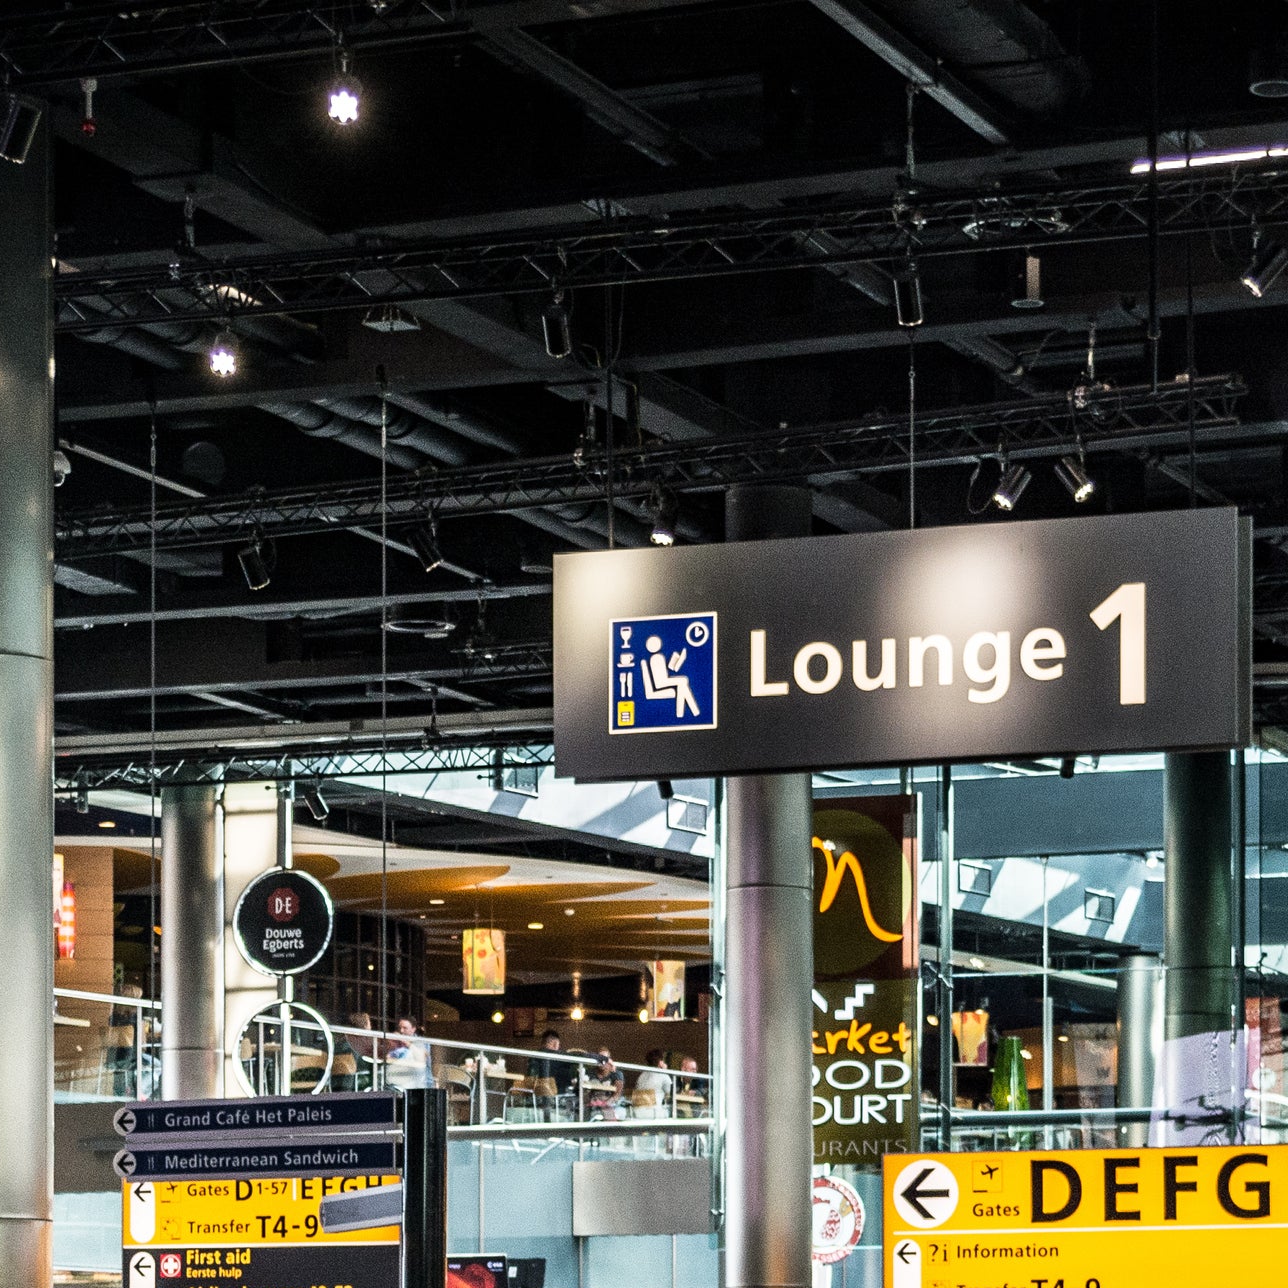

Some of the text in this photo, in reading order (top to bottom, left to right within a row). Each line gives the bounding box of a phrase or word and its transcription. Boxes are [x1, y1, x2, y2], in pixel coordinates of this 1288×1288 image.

[750, 582, 1146, 705] Lounge 1
[266, 928, 302, 938] Douwe
[263, 938, 304, 953] Egberts
[164, 1106, 332, 1127] Grand Café Het Paleis
[813, 1138, 907, 1156] URANTS
[164, 1149, 360, 1169] Mediterranean Sandwich
[187, 1182, 230, 1197] Gates
[972, 1203, 1021, 1218] Gates
[187, 1214, 319, 1239] Transfer T4-9
[186, 1248, 251, 1266] First aid
[956, 1244, 1059, 1259] Information
[186, 1266, 243, 1280] Eerste hulp
